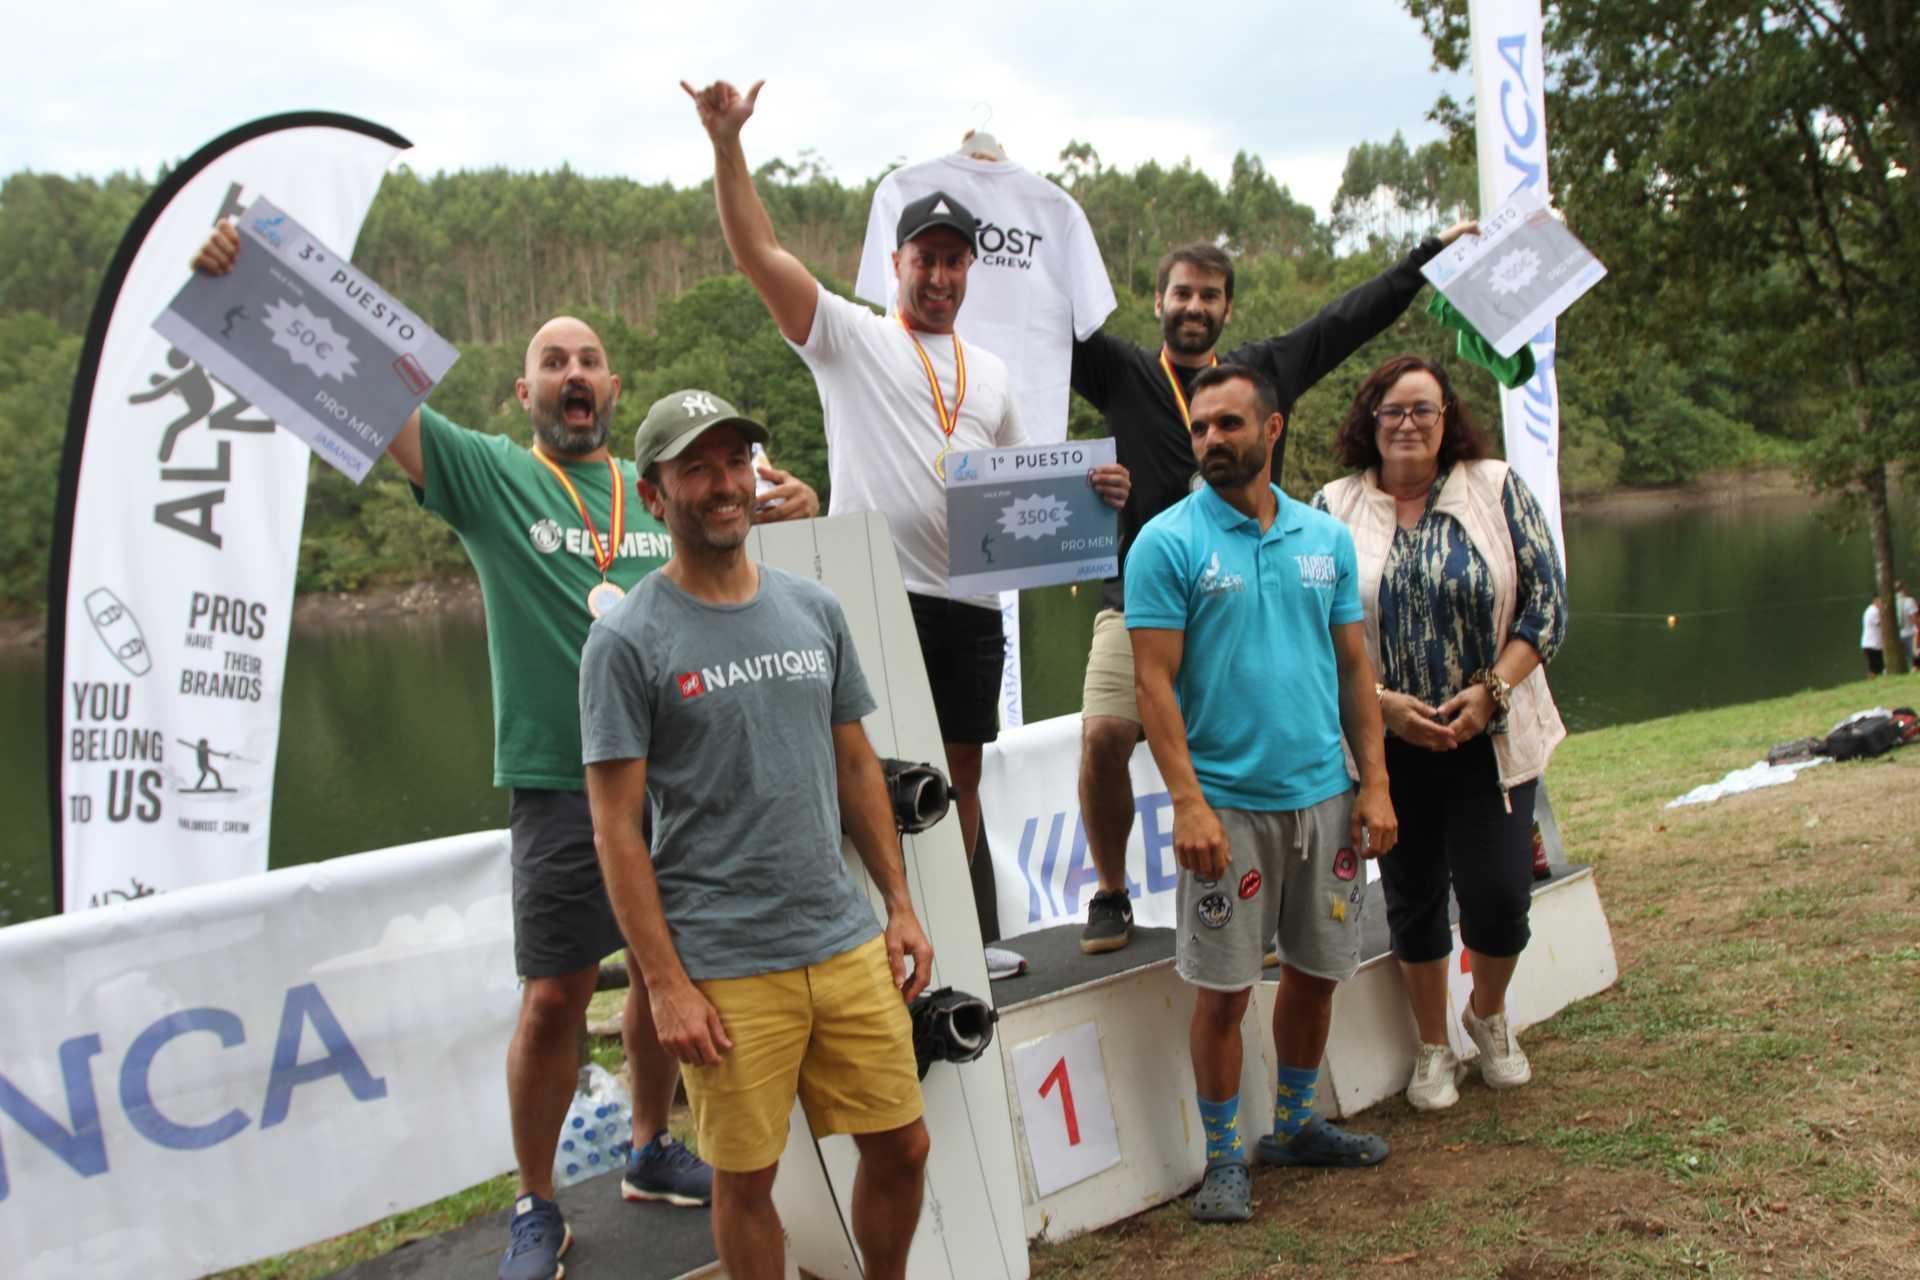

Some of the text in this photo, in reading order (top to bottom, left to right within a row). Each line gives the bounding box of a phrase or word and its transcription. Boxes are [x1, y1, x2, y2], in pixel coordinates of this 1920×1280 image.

[982, 254, 1032, 270] CREW
[330, 269, 415, 341] PUESTO
[286, 319, 334, 361] 50€
[314, 390, 384, 448] PRO MEN
[1015, 450, 1083, 470] PUESTO
[1017, 507, 1061, 526] 350€
[1061, 535, 1113, 552] PRO MEN
[189, 592, 267, 641] PROS
[184, 632, 214, 651] HAVE
[223, 651, 262, 676] THEIR
[701, 650, 828, 693] NAUTIQUE
[71, 682, 131, 721] YOU
[179, 670, 263, 702] BRANDS
[70, 728, 163, 763] BELONG
[69, 769, 162, 824] TO US
[1038, 1056, 1080, 1146] 1
